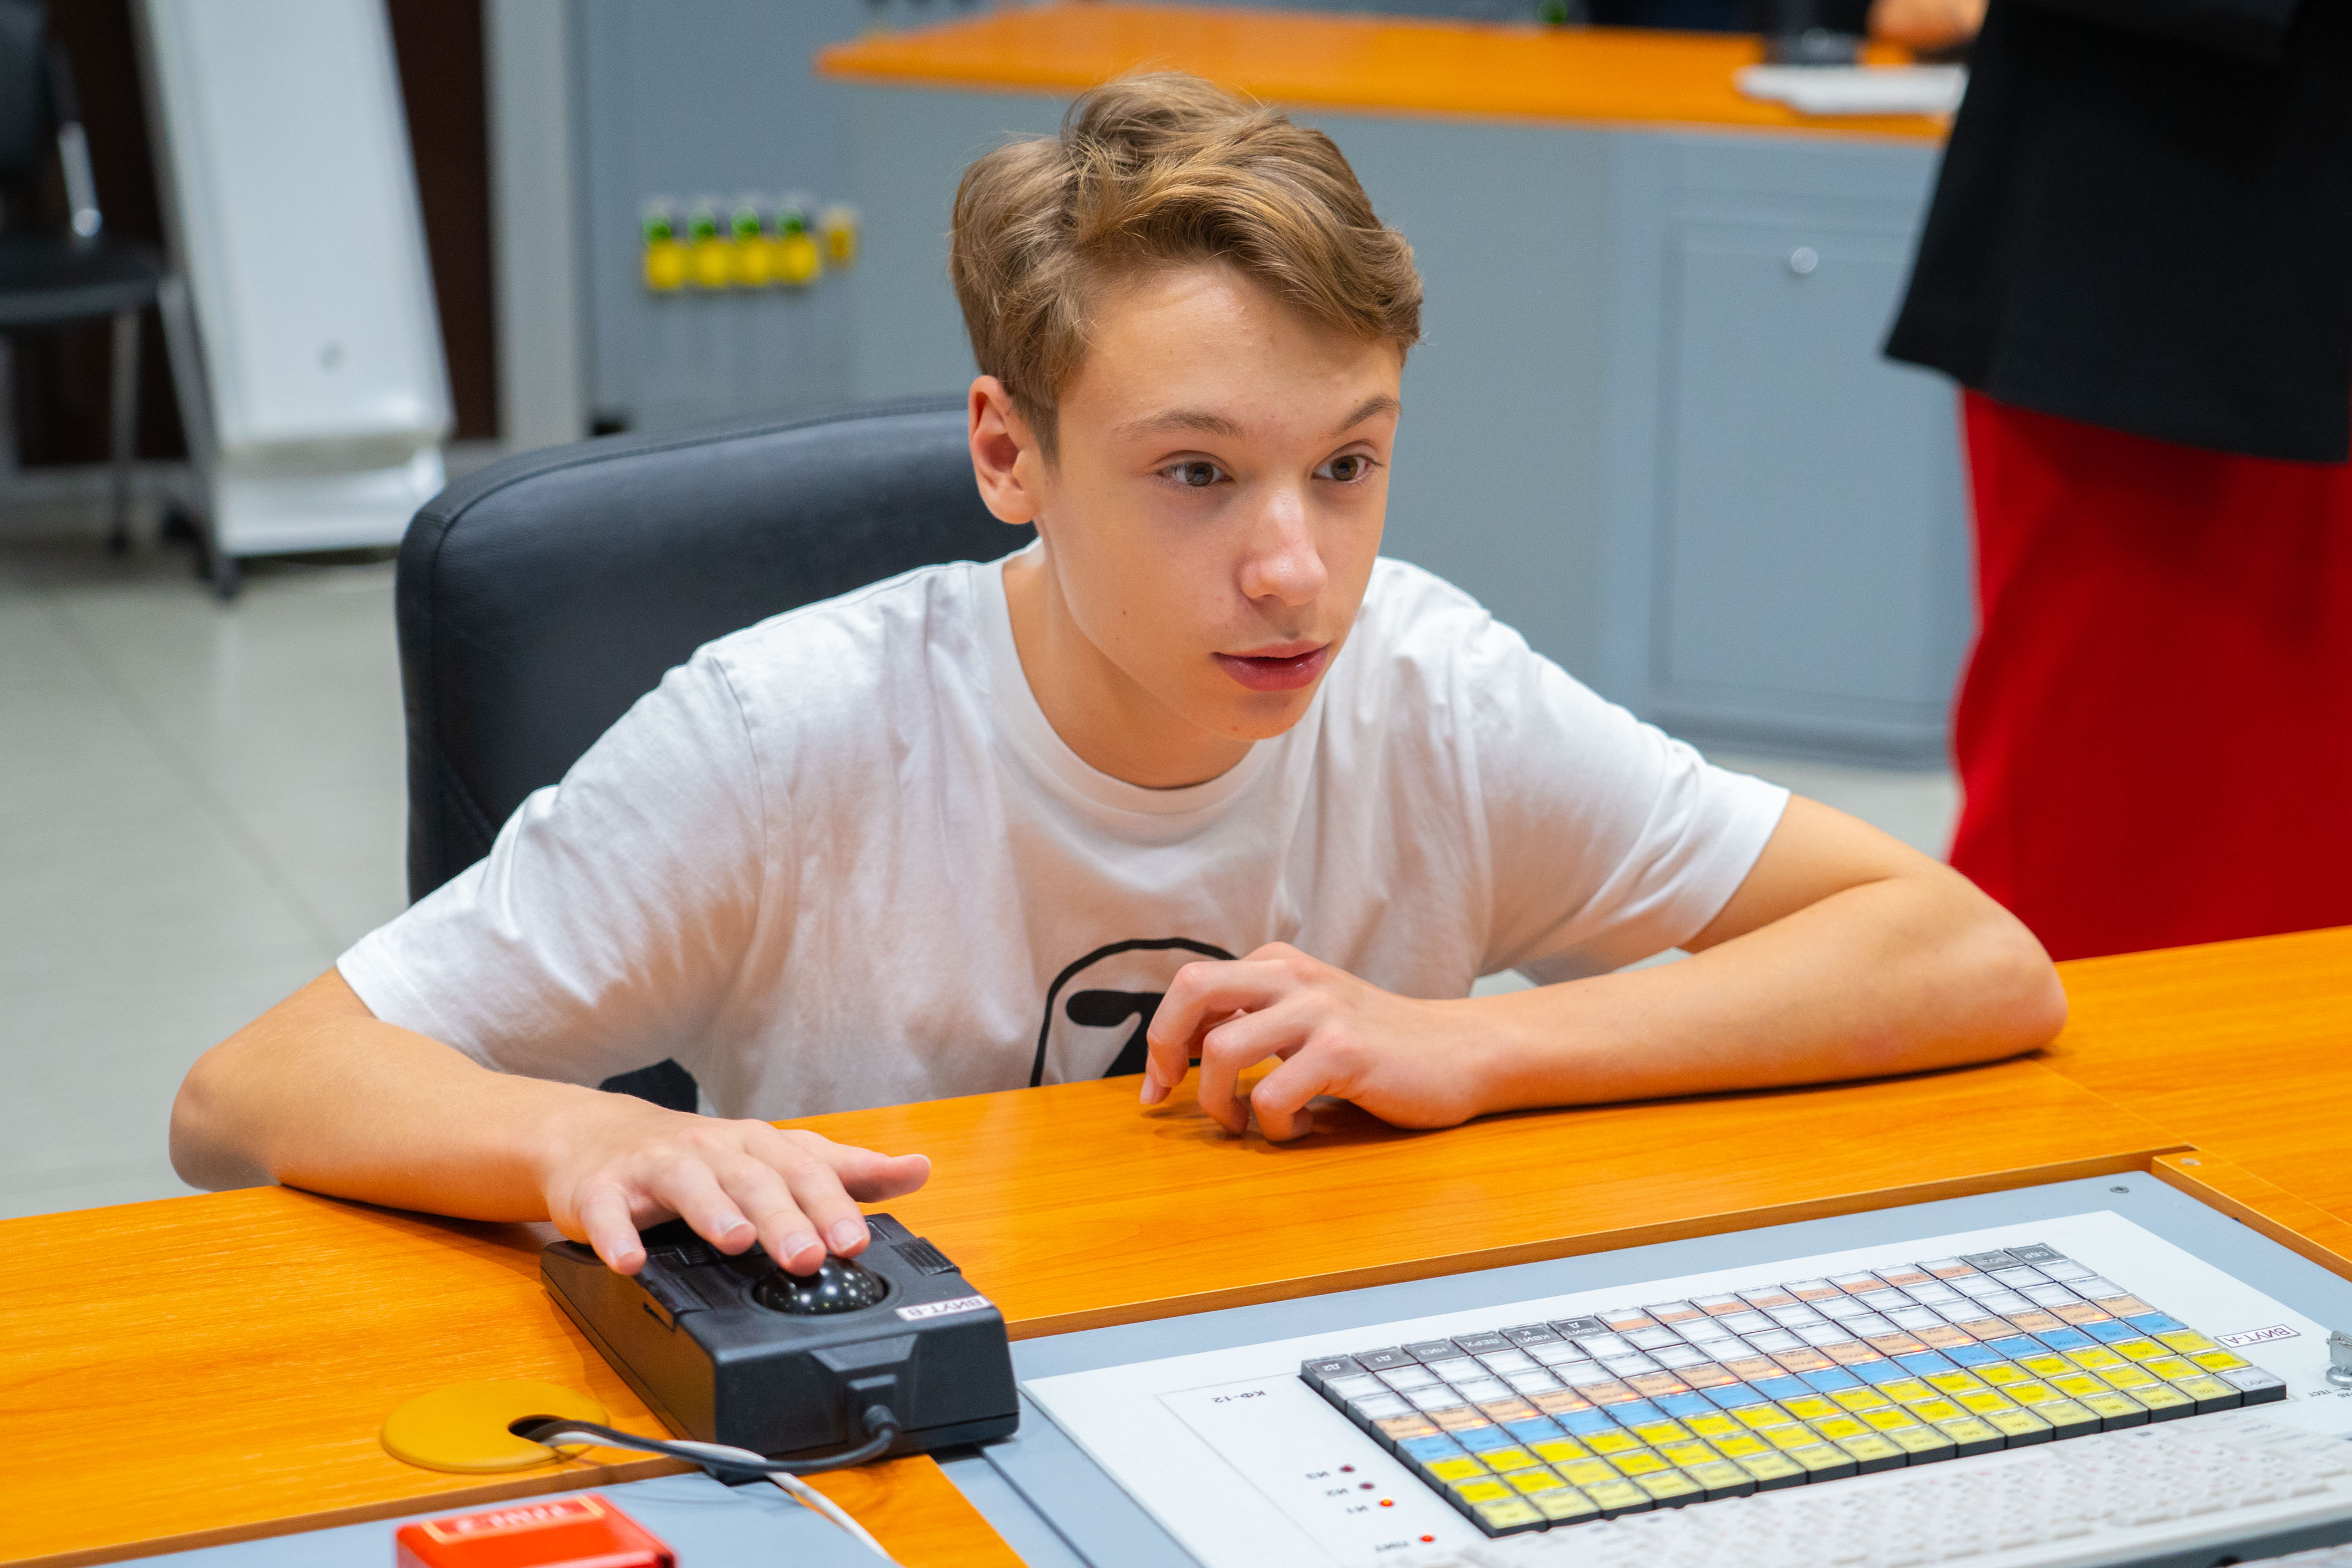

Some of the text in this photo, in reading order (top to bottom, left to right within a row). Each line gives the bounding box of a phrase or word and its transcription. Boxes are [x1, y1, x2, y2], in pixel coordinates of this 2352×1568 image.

[907, 1298, 982, 1316] ВИУТ-В
[1564, 1327, 1601, 1336] КВИТ
[2224, 1327, 2291, 1345] ВИУТ-А
[1463, 1338, 1501, 1348] ВЕРХ
[1515, 1334, 1553, 1343] КВИТ
[1418, 1347, 1449, 1355] НИЗ
[1320, 1363, 1344, 1371] Д2
[1211, 1389, 1266, 1403] КФ-12
